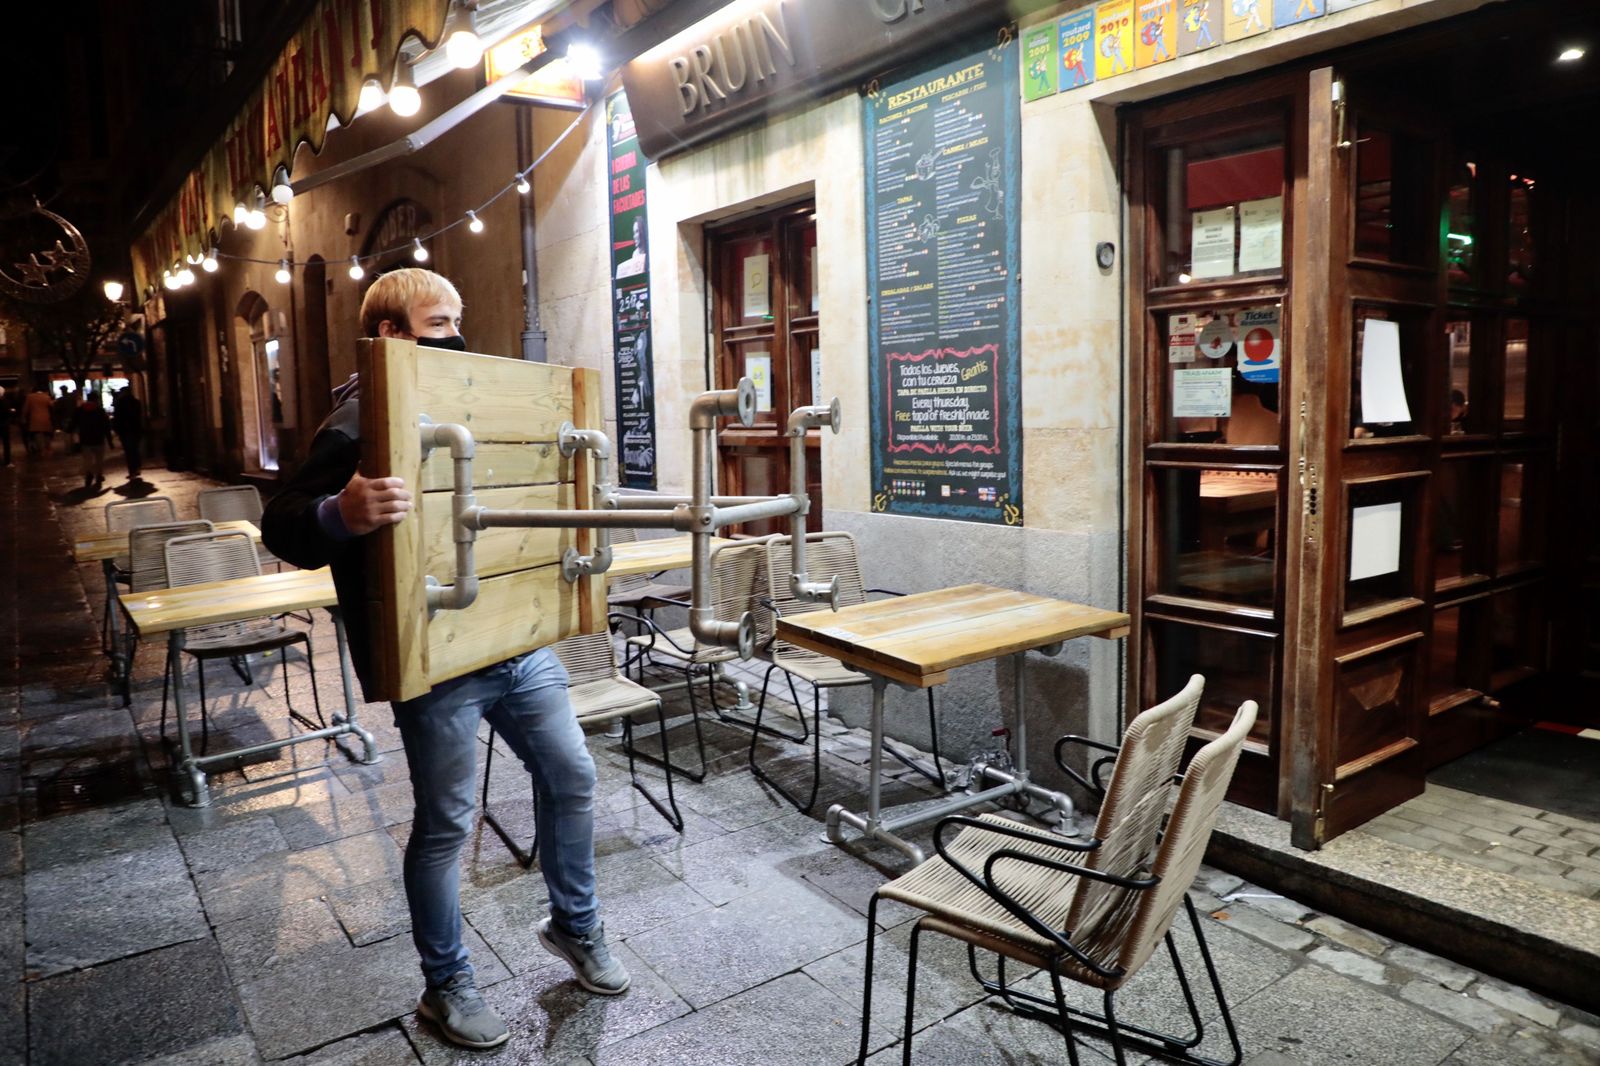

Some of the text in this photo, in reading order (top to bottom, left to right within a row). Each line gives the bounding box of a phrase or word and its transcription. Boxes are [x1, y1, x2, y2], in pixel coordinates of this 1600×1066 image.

[1142, 3, 1170, 22] 2011
[1100, 17, 1129, 35] 2010
[1063, 30, 1090, 48] 2009
[669, 2, 797, 116] BRUIN
[1028, 43, 1050, 58] 2001
[888, 62, 984, 110] RESTAURANTE
[1244, 311, 1274, 321] Ticket
[961, 360, 988, 381] Gratis
[902, 377, 917, 388] con
[918, 375, 927, 387] tu
[912, 397, 933, 412] Every
[895, 411, 911, 422] Free
[912, 411, 929, 424] tapa
[929, 410, 939, 420] of
[966, 408, 990, 420] made
